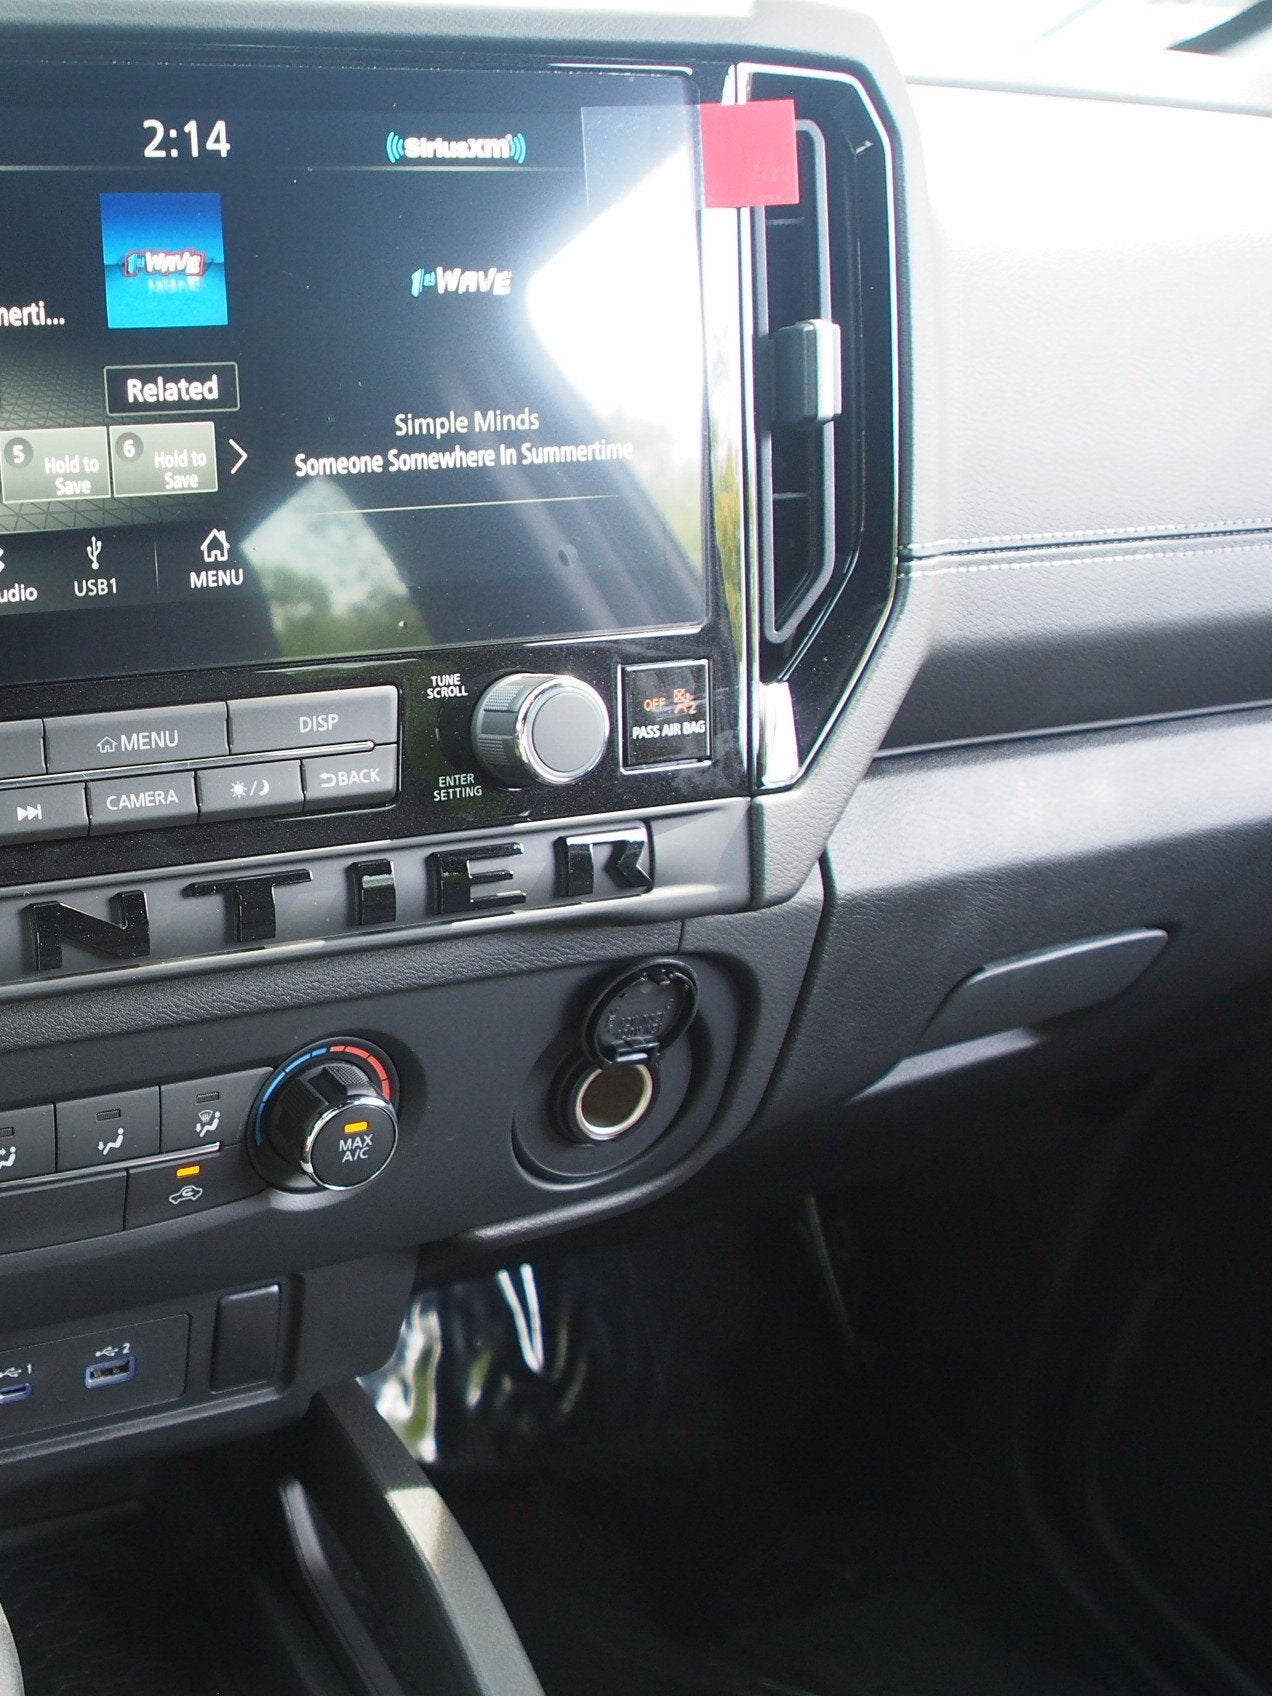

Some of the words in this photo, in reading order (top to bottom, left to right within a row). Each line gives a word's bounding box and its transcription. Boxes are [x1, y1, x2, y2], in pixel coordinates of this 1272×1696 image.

[143, 119, 231, 158] 2:14
[436, 266, 512, 295] WAVE
[126, 374, 219, 403] Related
[394, 410, 468, 441] Simple
[474, 407, 540, 433] Minds
[12, 444, 25, 464] 5
[123, 439, 136, 458] 6
[295, 451, 383, 478] Someone
[388, 447, 496, 473] Somewhere
[500, 444, 518, 467] In
[521, 439, 634, 466] Summertime
[44, 455, 78, 476] Hold
[82, 456, 100, 473] to
[154, 449, 187, 470] Hold
[189, 450, 207, 467] to
[55, 476, 91, 496] Save
[164, 470, 199, 489] Save
[74, 578, 118, 597] USB1
[189, 568, 245, 588] MENU
[430, 674, 461, 687] TUNE
[427, 685, 469, 699] SCROLL
[643, 697, 666, 711] OFF
[299, 713, 340, 734] DISP
[632, 724, 661, 739] PASS
[661, 722, 682, 737] AIR
[682, 720, 706, 735] BAG
[120, 729, 180, 752] MENU
[337, 767, 382, 787] BACK
[438, 773, 475, 787] ENTER
[106, 789, 179, 811] CAMERA
[433, 785, 483, 801] SETTING
[339, 1133, 373, 1152] MAX
[342, 1147, 370, 1163] A/C
[122, 1342, 131, 1354] 2
